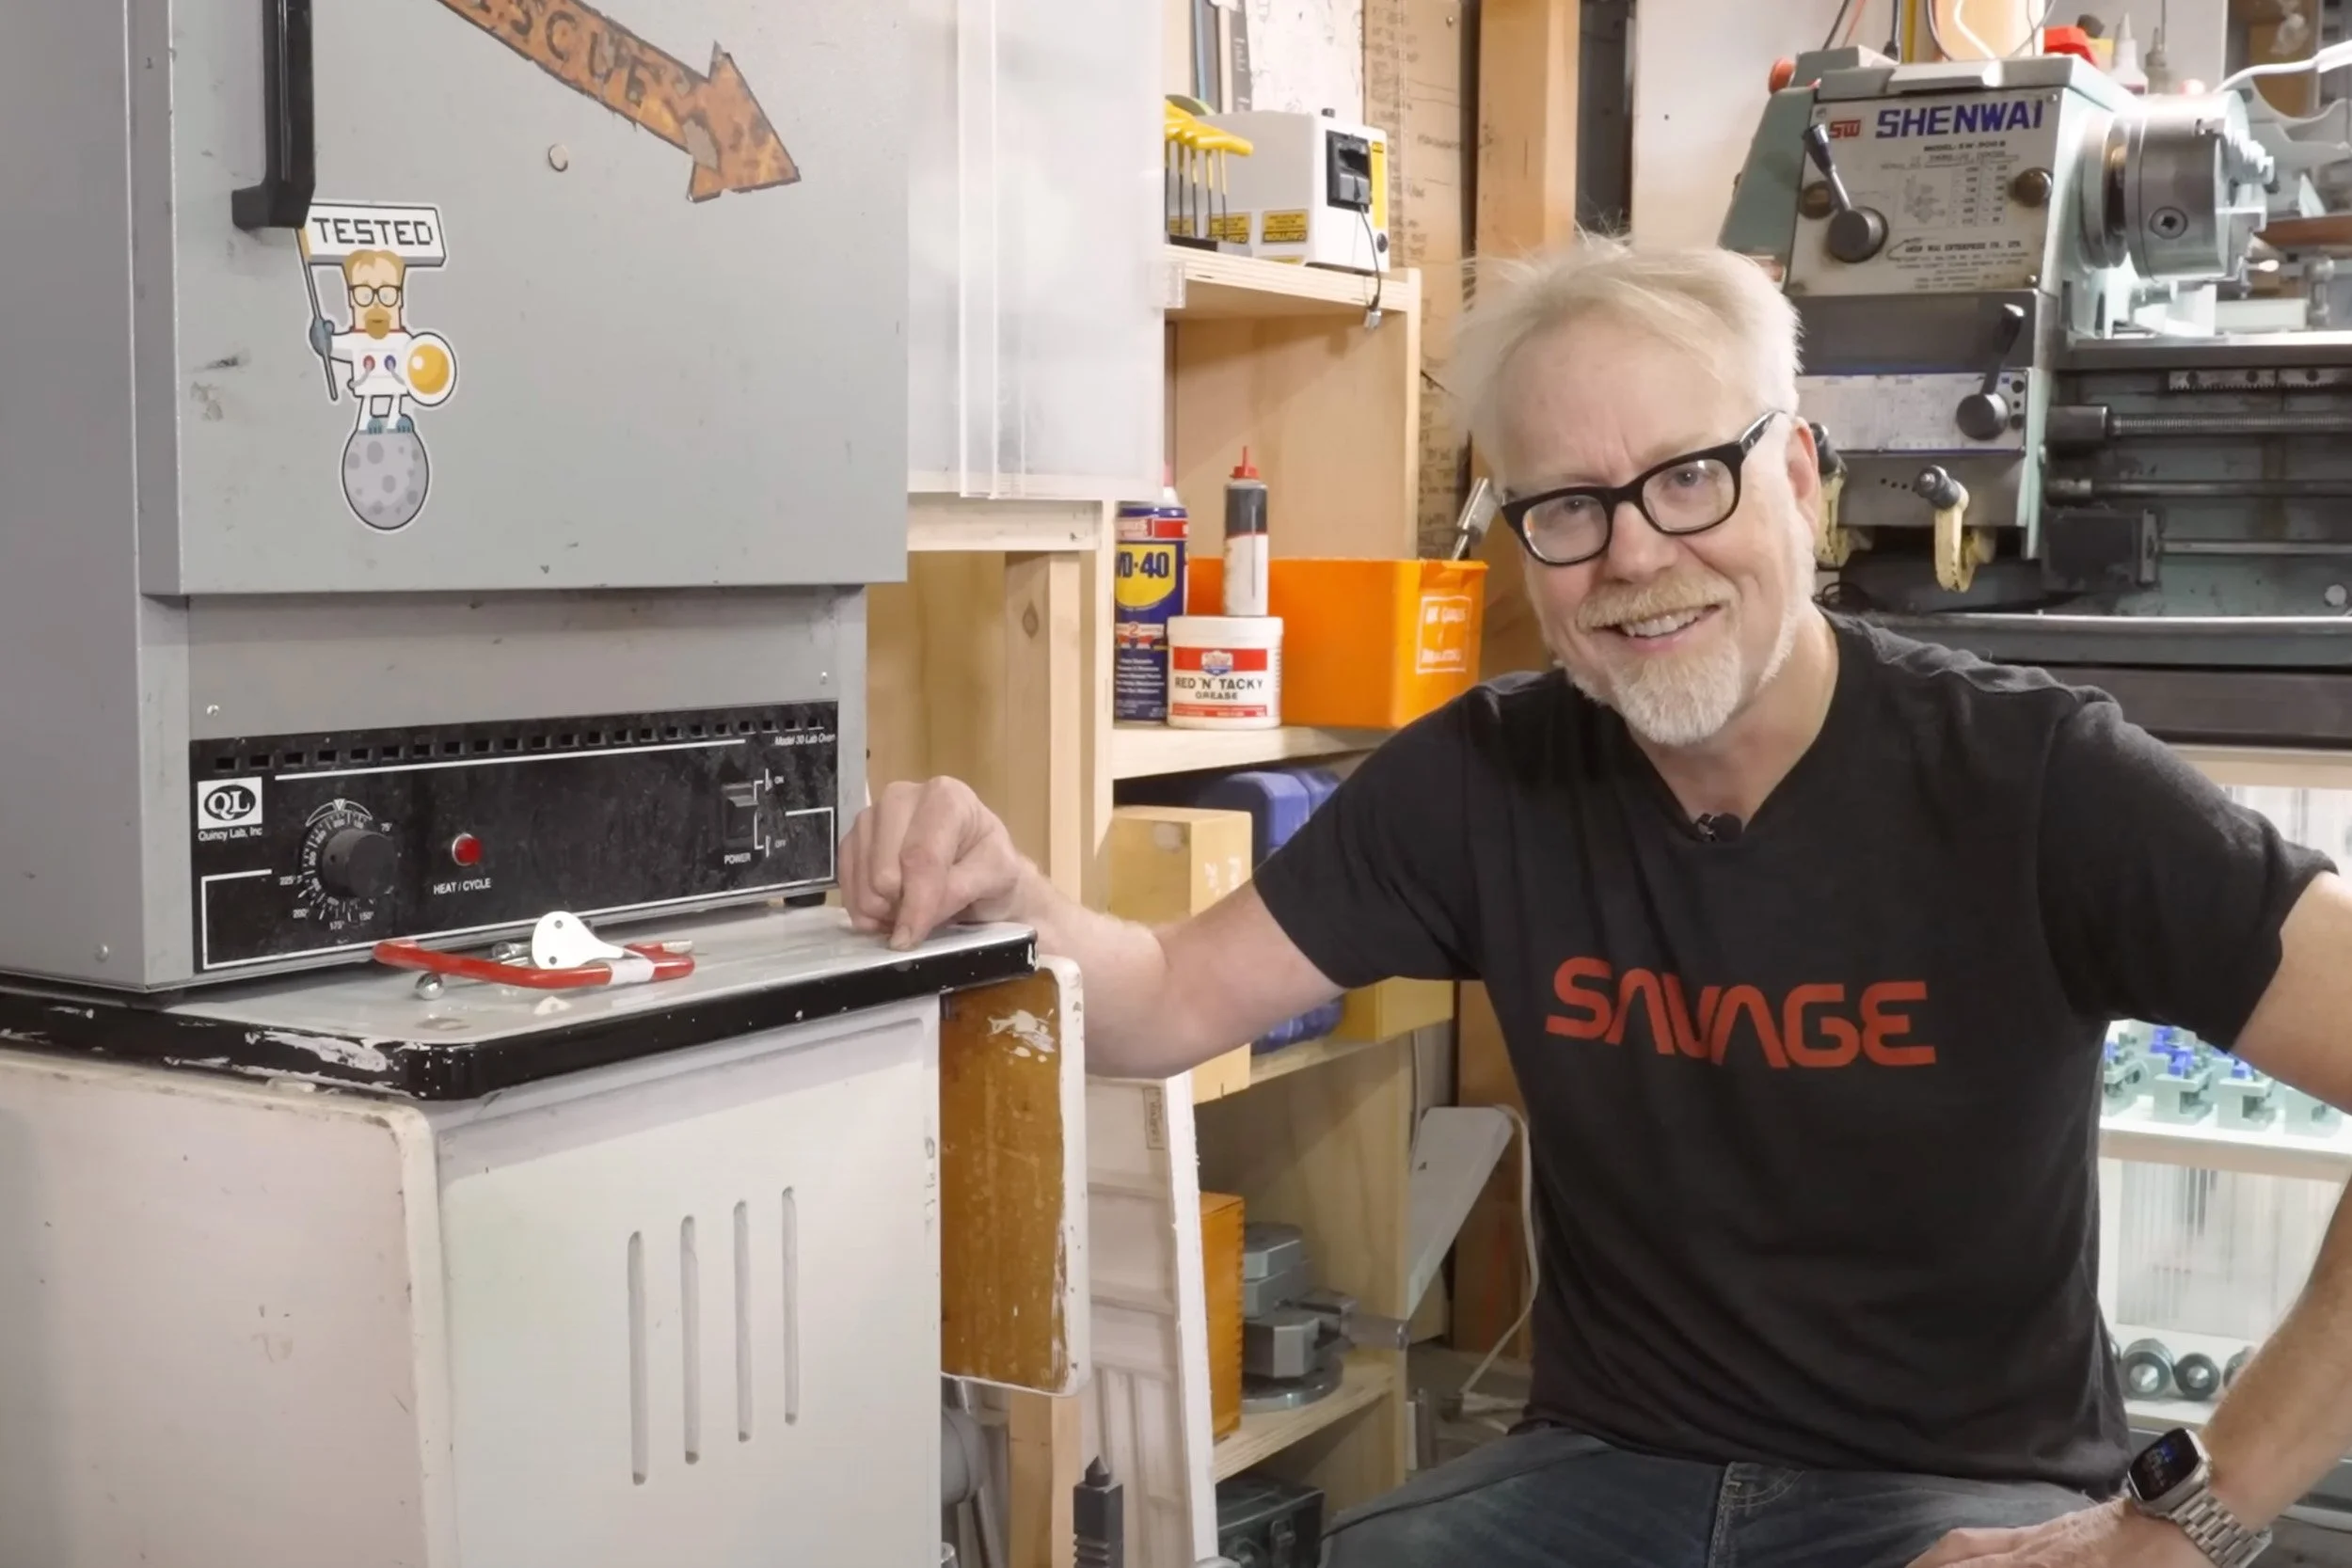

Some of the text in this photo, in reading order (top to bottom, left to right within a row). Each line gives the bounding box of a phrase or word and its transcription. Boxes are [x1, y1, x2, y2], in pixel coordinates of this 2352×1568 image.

[471, 0, 668, 108] SCUE
[1875, 99, 2043, 138] SHENWAI
[1829, 119, 1861, 139] SW
[311, 217, 433, 245] TESTED
[1117, 551, 1169, 578] D-40
[1174, 676, 1196, 689] RED
[1218, 678, 1263, 689] TACKY
[1195, 691, 1238, 700] GREASE
[804, 734, 818, 744] Lab
[818, 733, 835, 743] Oven
[208, 791, 250, 820] QL
[198, 831, 228, 841] Quincy
[723, 852, 751, 864] POWER
[434, 882, 456, 895] HEAT
[462, 878, 491, 892] CYCLE
[1545, 956, 1936, 1069] SAVAGE
